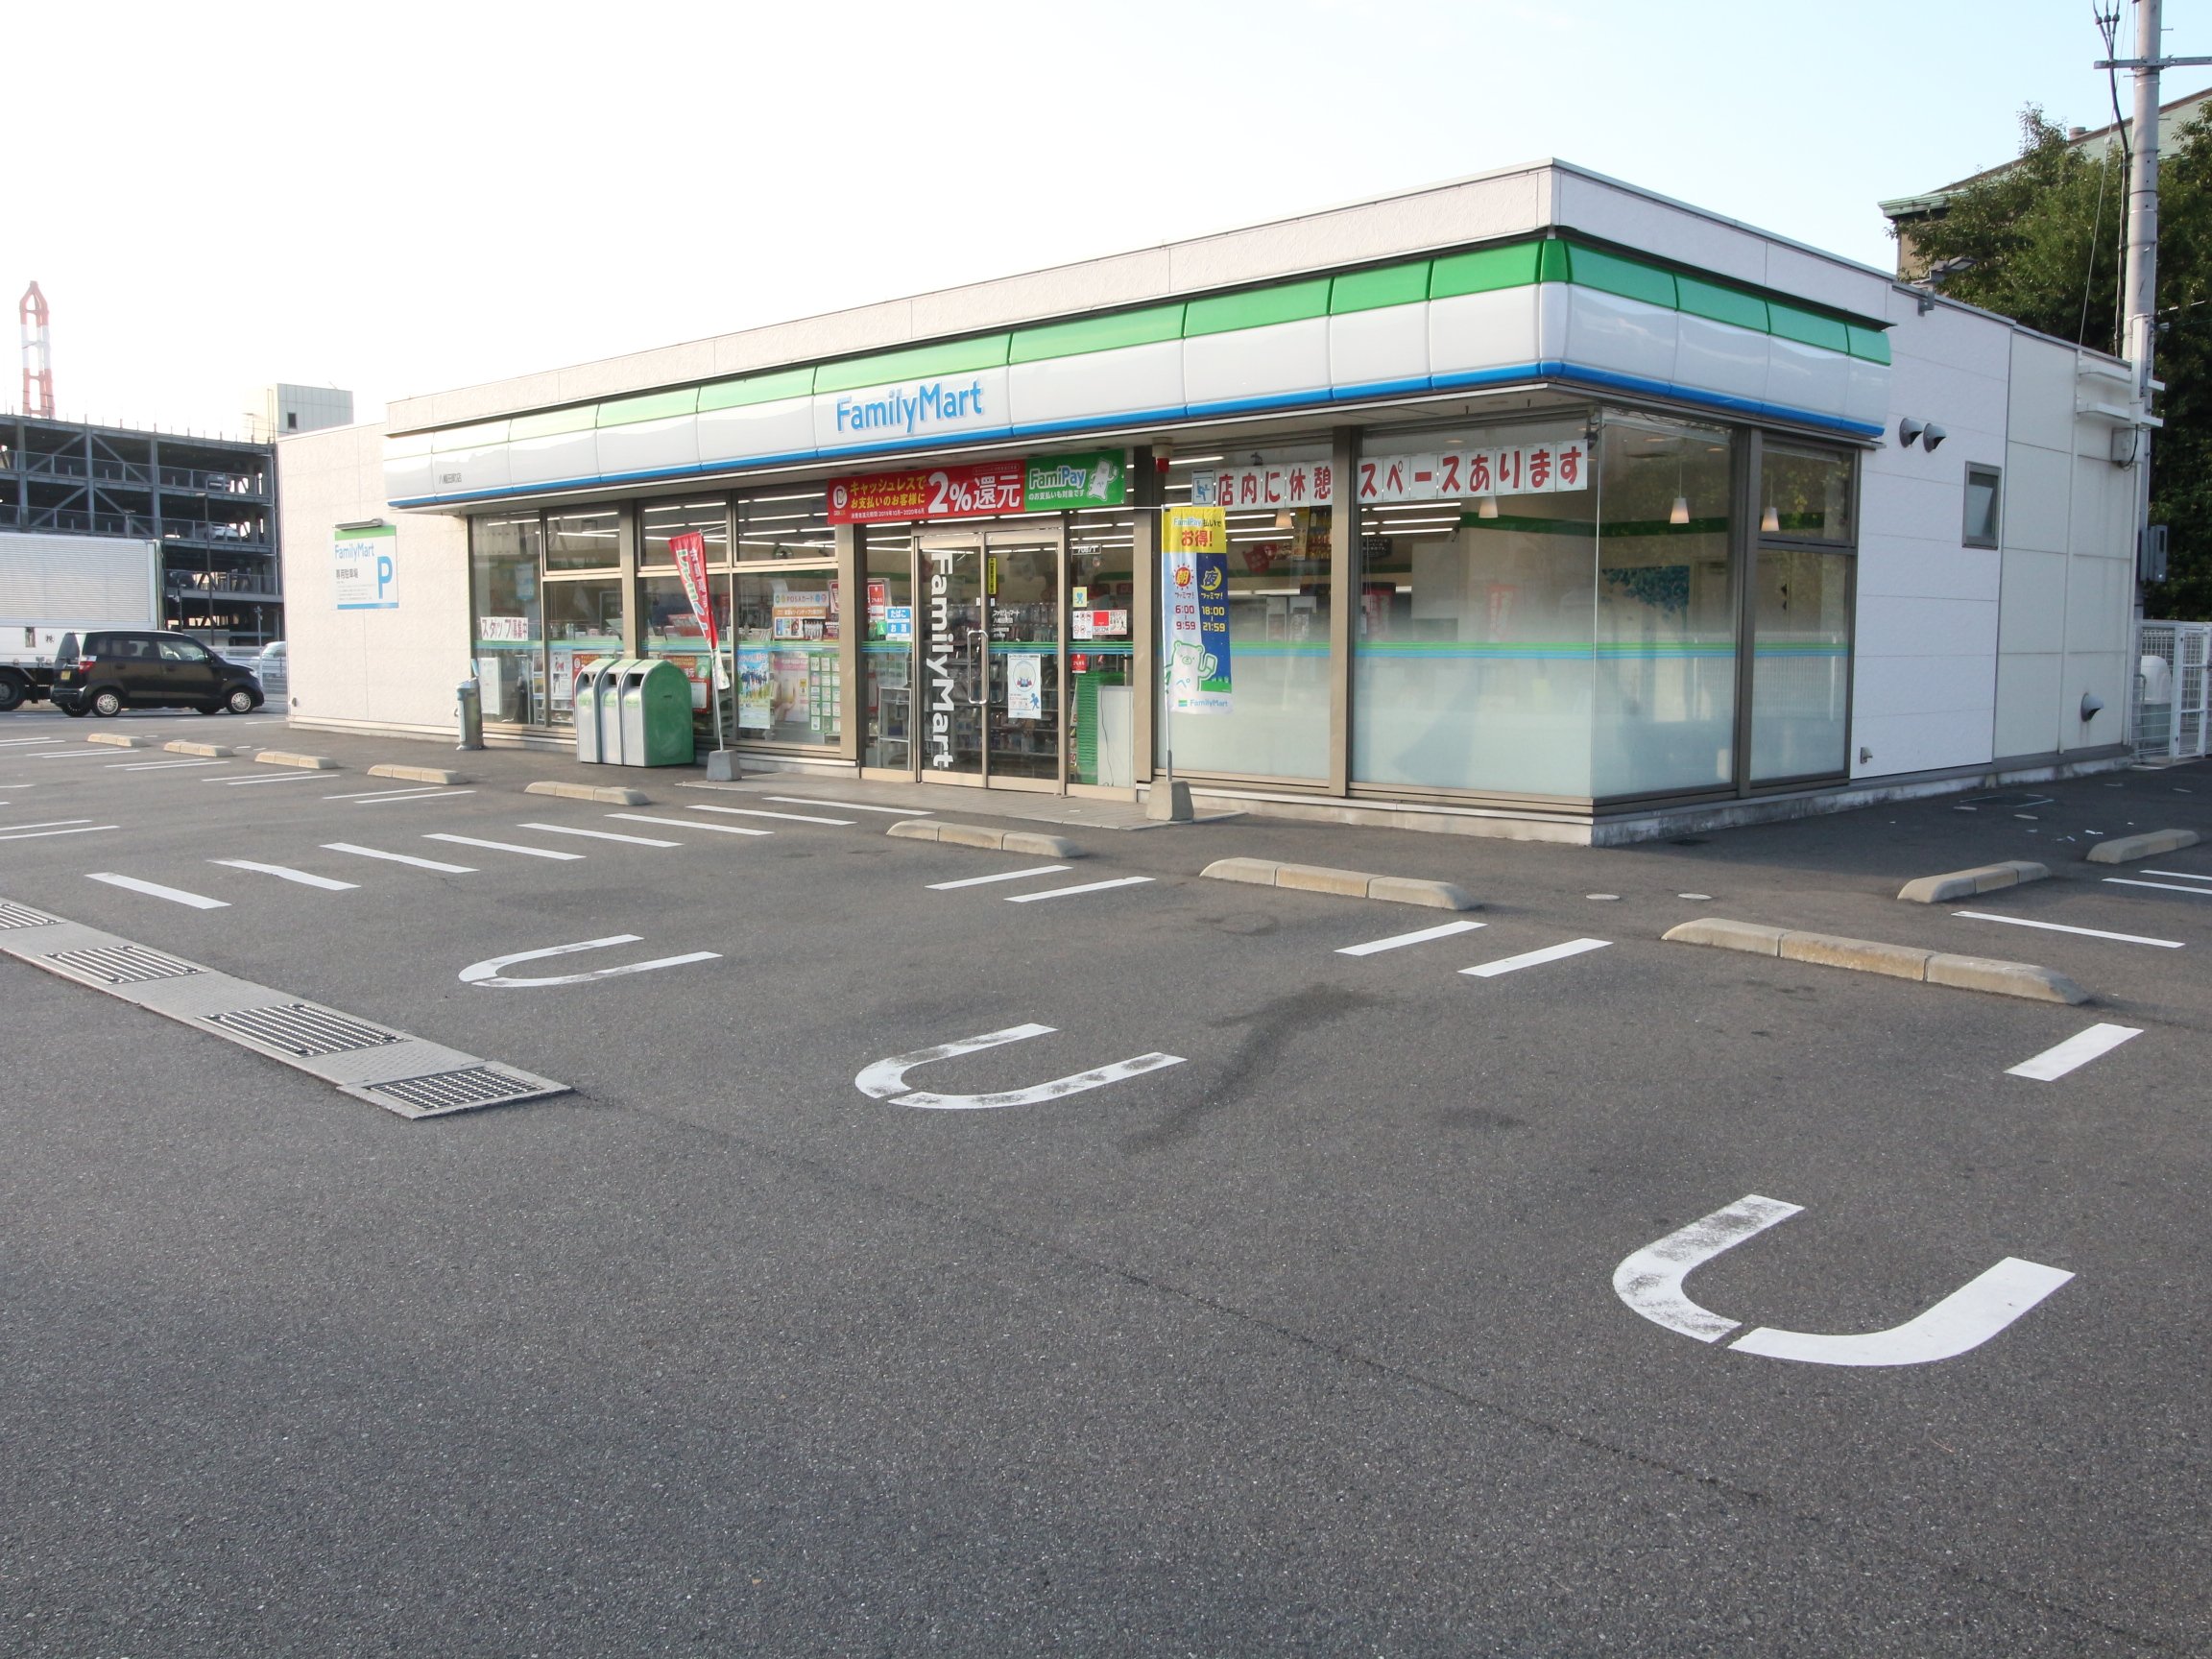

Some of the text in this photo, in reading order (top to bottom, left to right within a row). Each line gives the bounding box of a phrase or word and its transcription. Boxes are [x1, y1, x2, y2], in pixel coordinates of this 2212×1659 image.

[836, 378, 983, 433] FamilyMart
[1029, 466, 1087, 490] FamiPay
[1217, 446, 1582, 506] 店内に休憩 スペースあります
[850, 475, 926, 495] キャッシュレスで
[851, 493, 926, 509] お支払いのお客様に
[1029, 489, 1085, 500] のお支払いも対象です
[1181, 530, 1213, 547] お得!
[334, 542, 374, 562] FamilyMart
[377, 555, 394, 599] P
[1176, 569, 1190, 585] 朝
[1203, 570, 1219, 588] 夜
[890, 609, 907, 618] たばこ
[1175, 605, 1195, 614] 6:00
[1202, 606, 1225, 616] 18:00
[481, 617, 528, 639] スタッフ募集中
[1176, 621, 1196, 630] 9:59
[1203, 622, 1226, 632] 21:59
[926, 553, 954, 768] FamilyMart
[1190, 699, 1228, 708] FamilyMart
